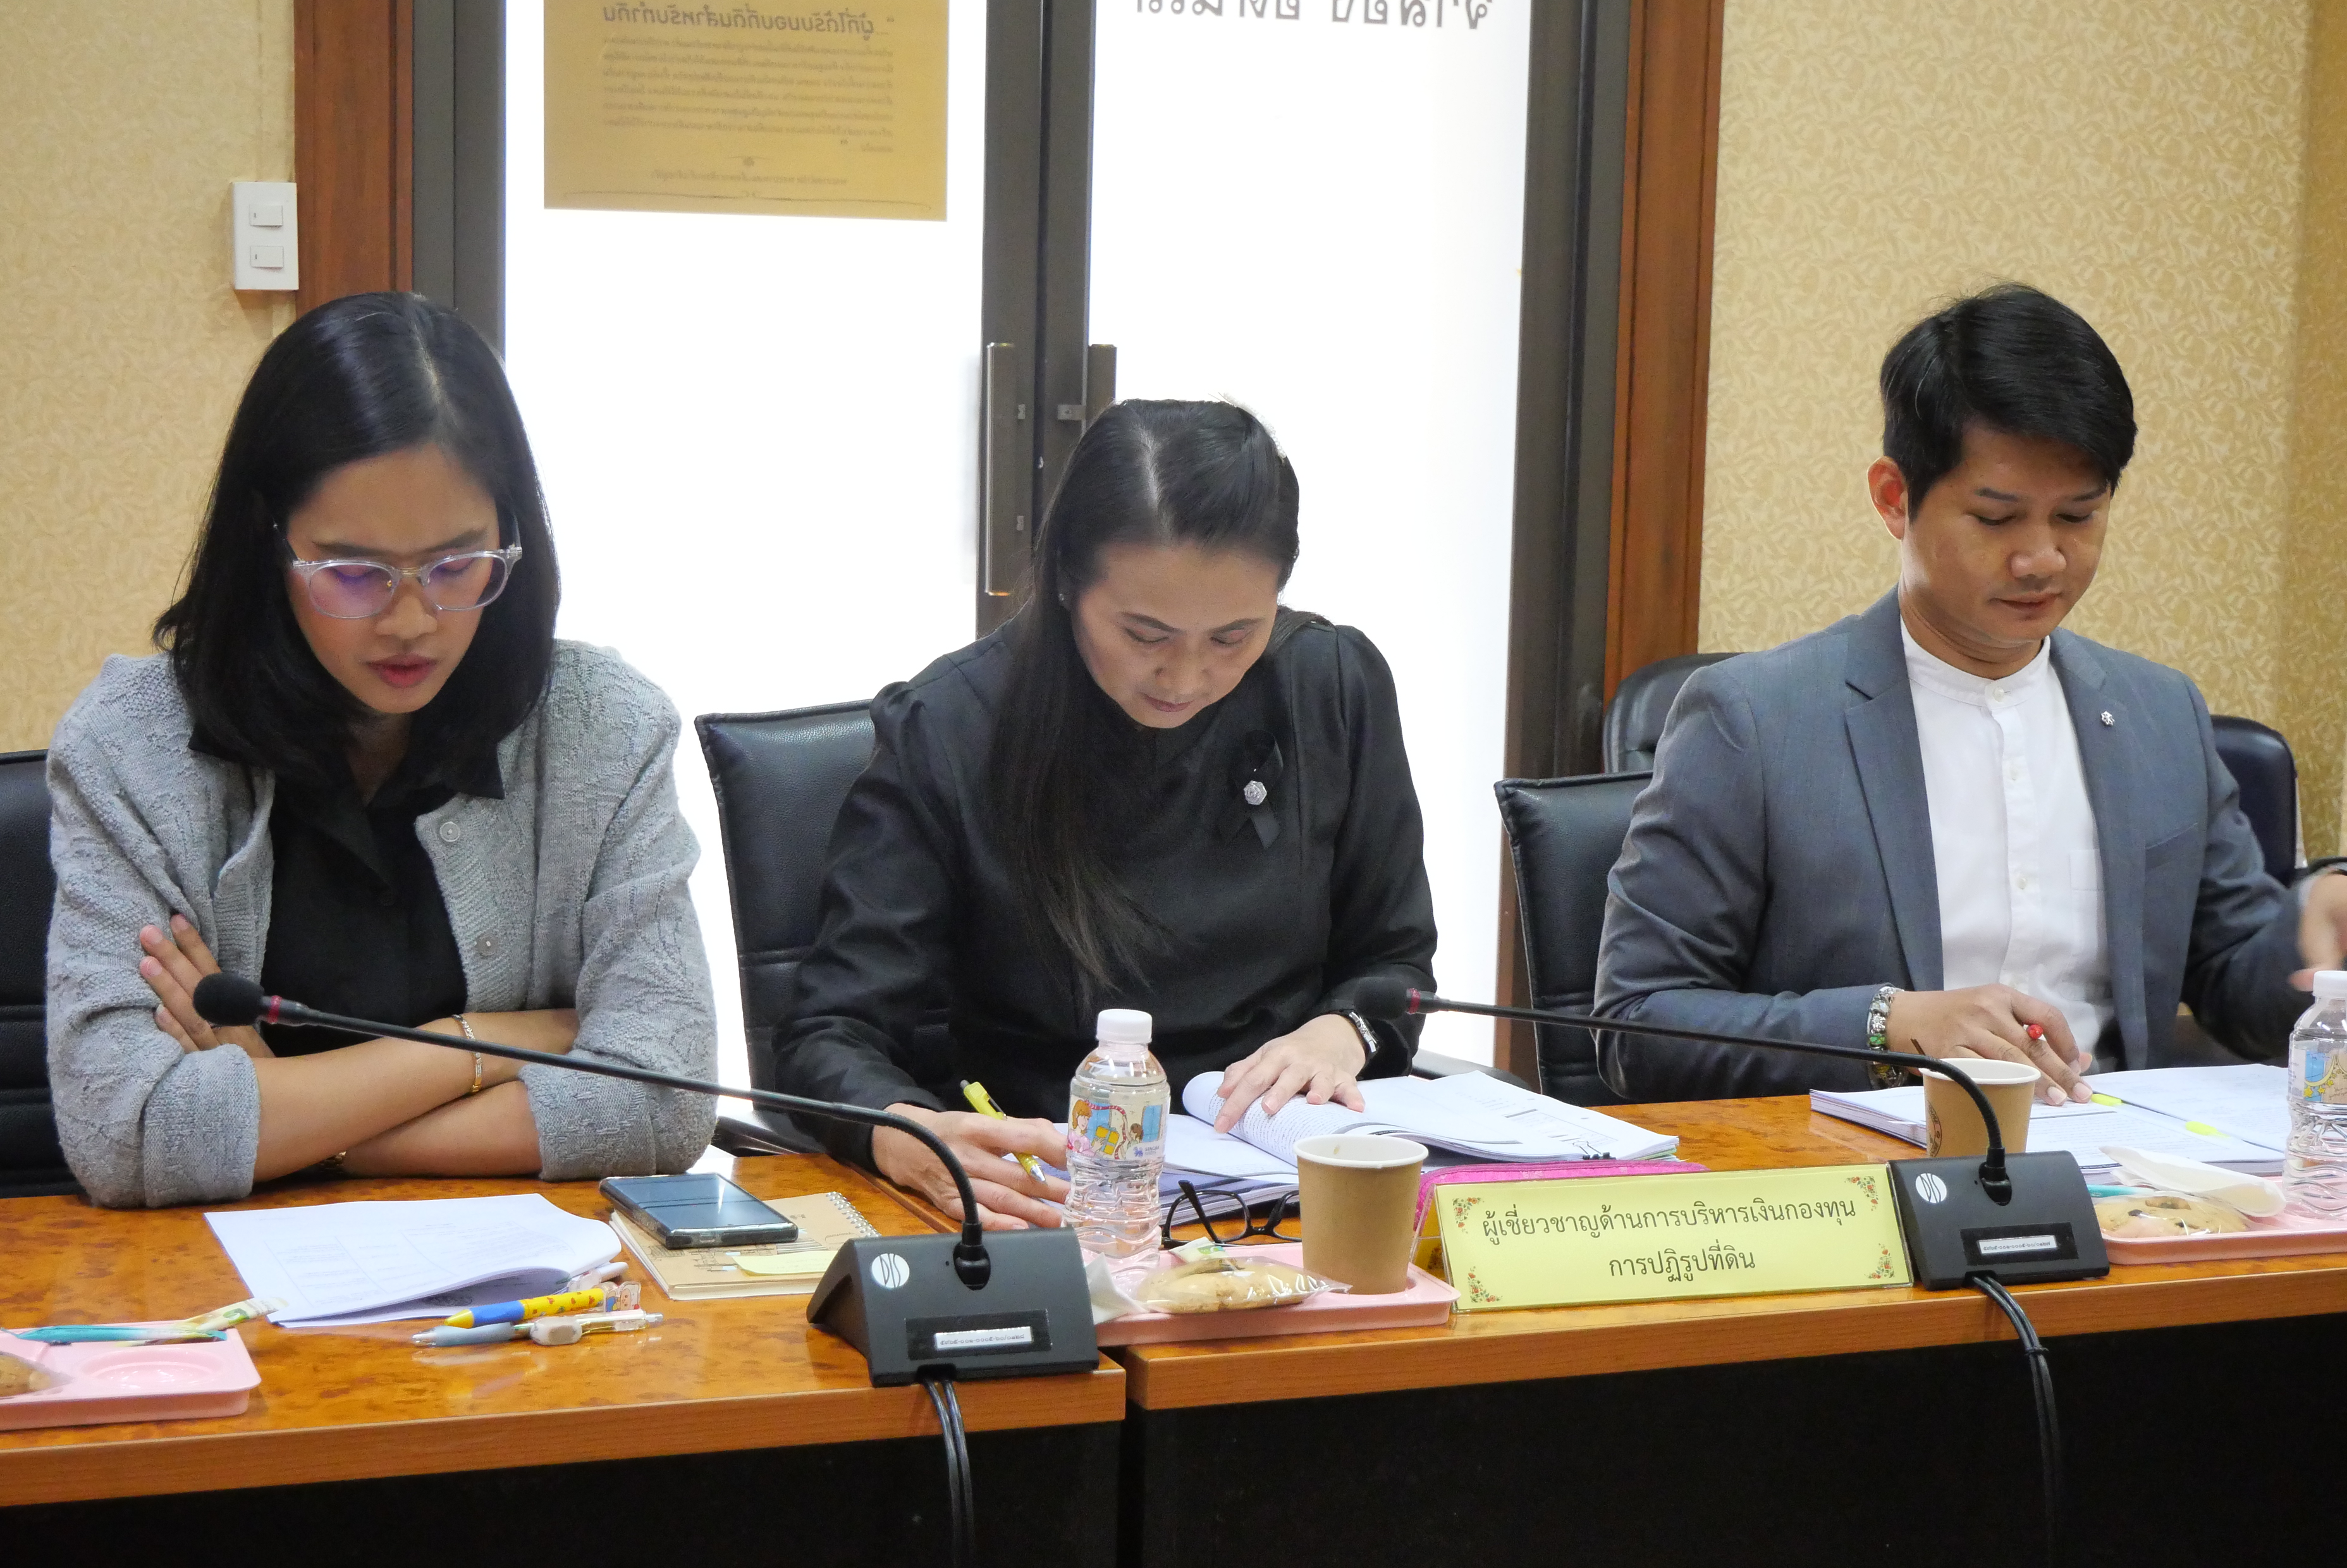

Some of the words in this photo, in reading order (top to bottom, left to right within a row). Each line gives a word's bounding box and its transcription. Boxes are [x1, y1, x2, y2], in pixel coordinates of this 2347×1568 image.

[1481, 1196, 1857, 1246] ผู้เชี่ยวชาญด้านการบริหารเงินกองทุน
[1609, 1240, 1756, 1282] การปฏิรูปที่ดิน
